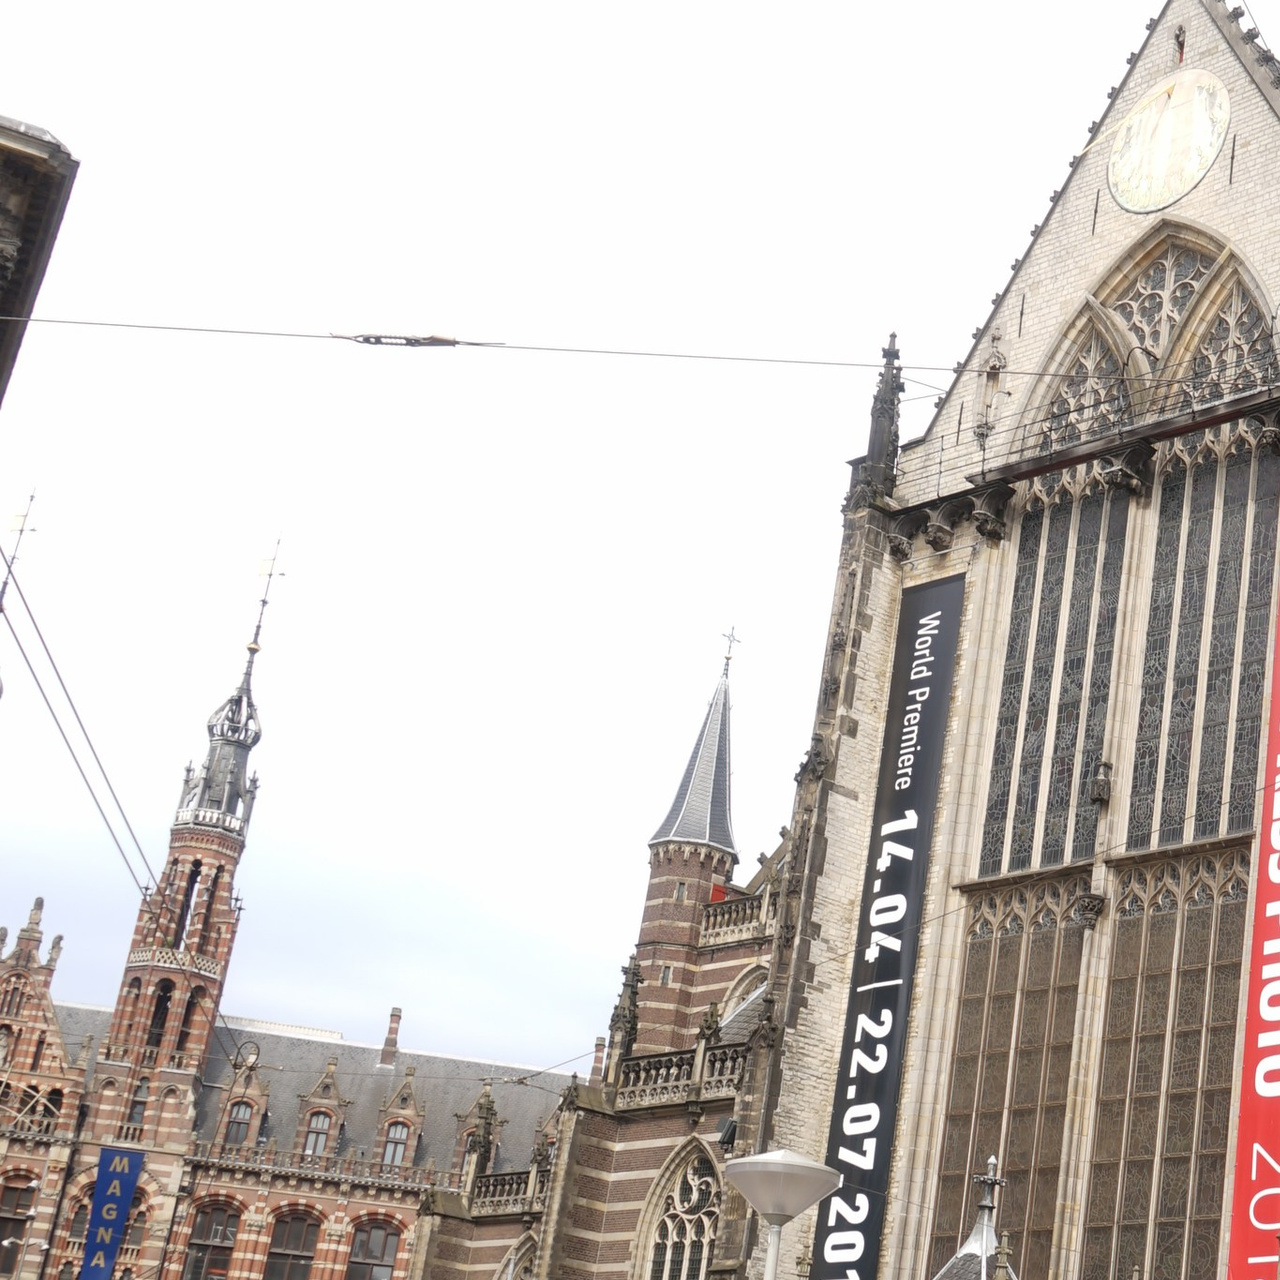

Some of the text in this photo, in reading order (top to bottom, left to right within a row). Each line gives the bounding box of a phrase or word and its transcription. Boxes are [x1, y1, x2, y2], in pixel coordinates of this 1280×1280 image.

[908, 610, 942, 680] World
[894, 685, 930, 791] Premiere
[864, 808, 919, 964] 14.04
[90, 1155, 130, 1269] MAGNA
